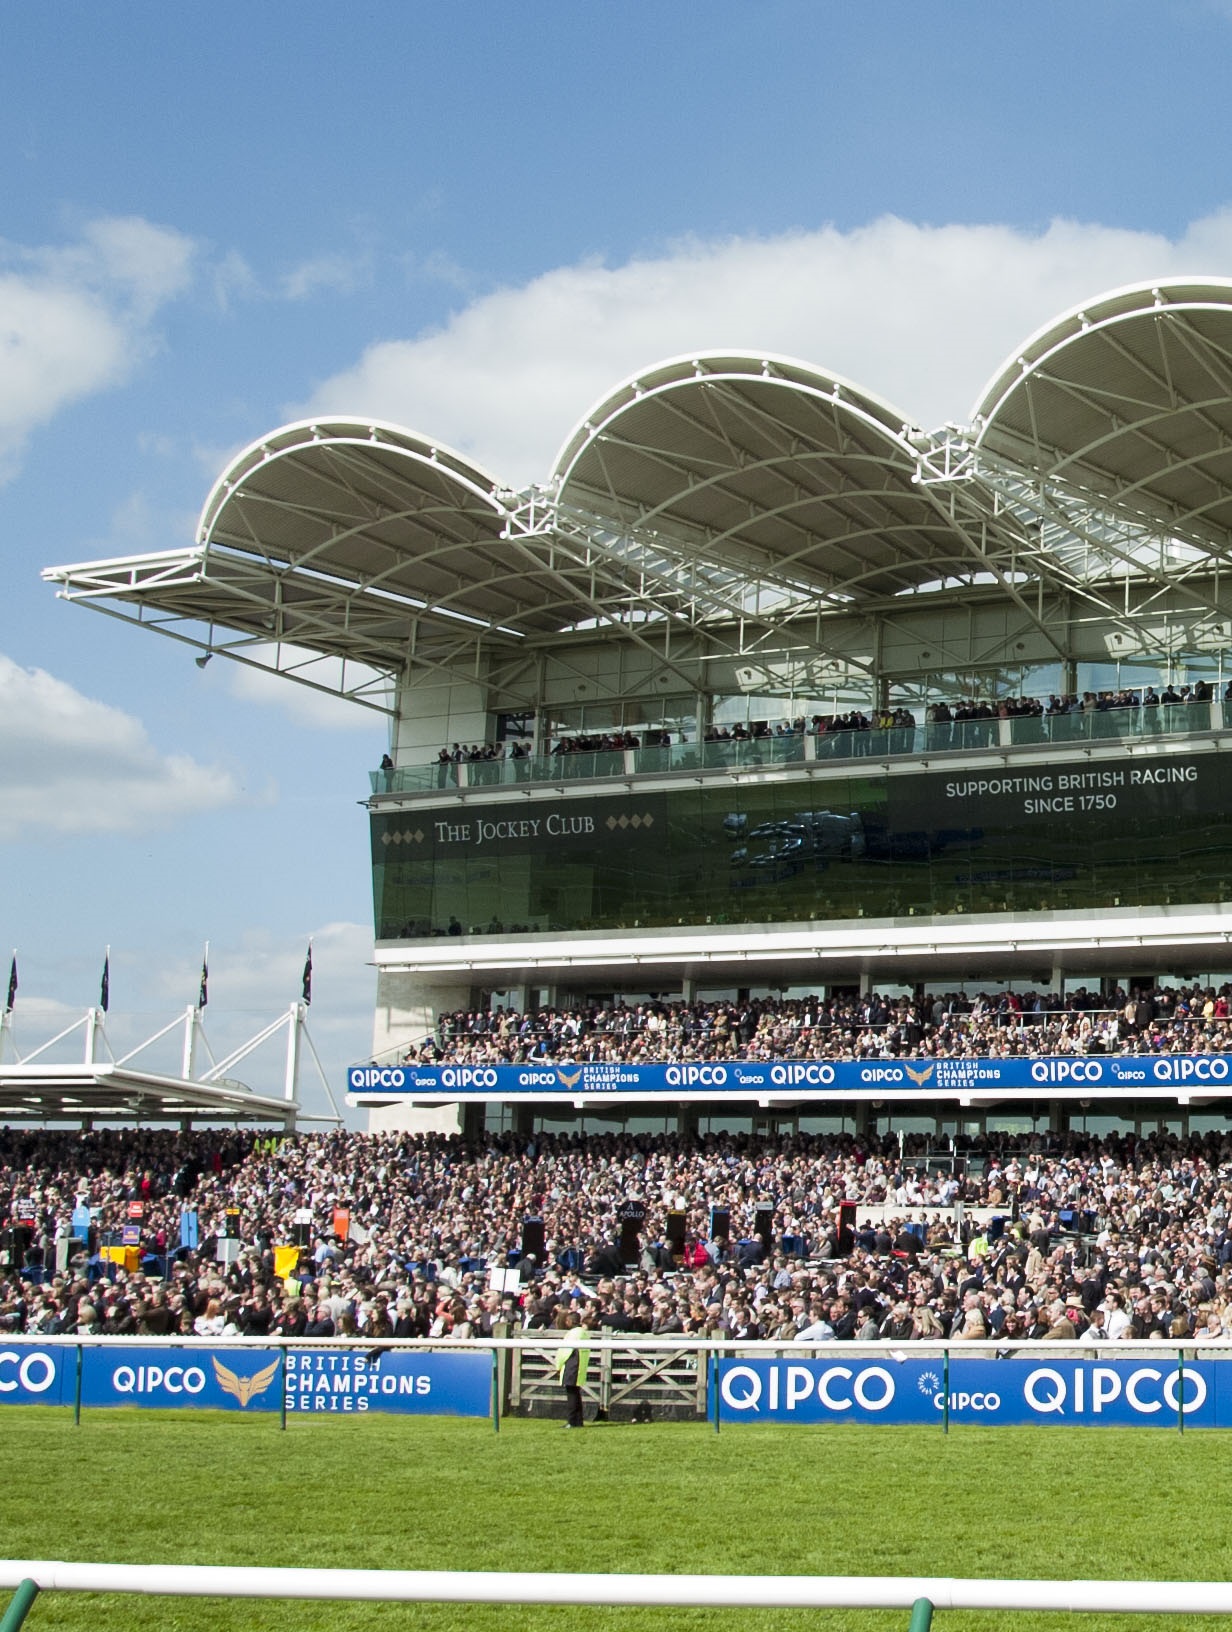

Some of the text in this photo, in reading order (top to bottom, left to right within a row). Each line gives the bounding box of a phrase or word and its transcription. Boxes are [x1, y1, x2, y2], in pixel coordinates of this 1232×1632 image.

[945, 766, 1198, 799] SUPPORTING BRITISH RACING
[1024, 793, 1117, 814] SINCE 1750
[476, 819, 541, 846] JOCKEY
[547, 814, 595, 836] CLUB
[352, 1069, 404, 1087] QIPCO
[441, 1069, 498, 1087] QIPCO
[519, 1072, 556, 1085] QIPCO
[584, 1074, 640, 1083] CHAMPIONS
[665, 1066, 728, 1086] QIPCO
[770, 1065, 835, 1085] QIPCO
[861, 1068, 904, 1082] QIPCO
[937, 1069, 1001, 1079] CHAMPIONS
[1031, 1061, 1103, 1082] QIPCO
[1153, 1059, 1229, 1080] QIPCO
[286, 1355, 381, 1371] BRITISH
[113, 1366, 206, 1393] QIPCO
[286, 1373, 431, 1395] CHAMPIONS
[721, 1366, 895, 1412] QIPCO
[933, 1392, 1001, 1411] QIPCO
[1024, 1368, 1207, 1415] QIPCO
[286, 1395, 369, 1411] SERIES
